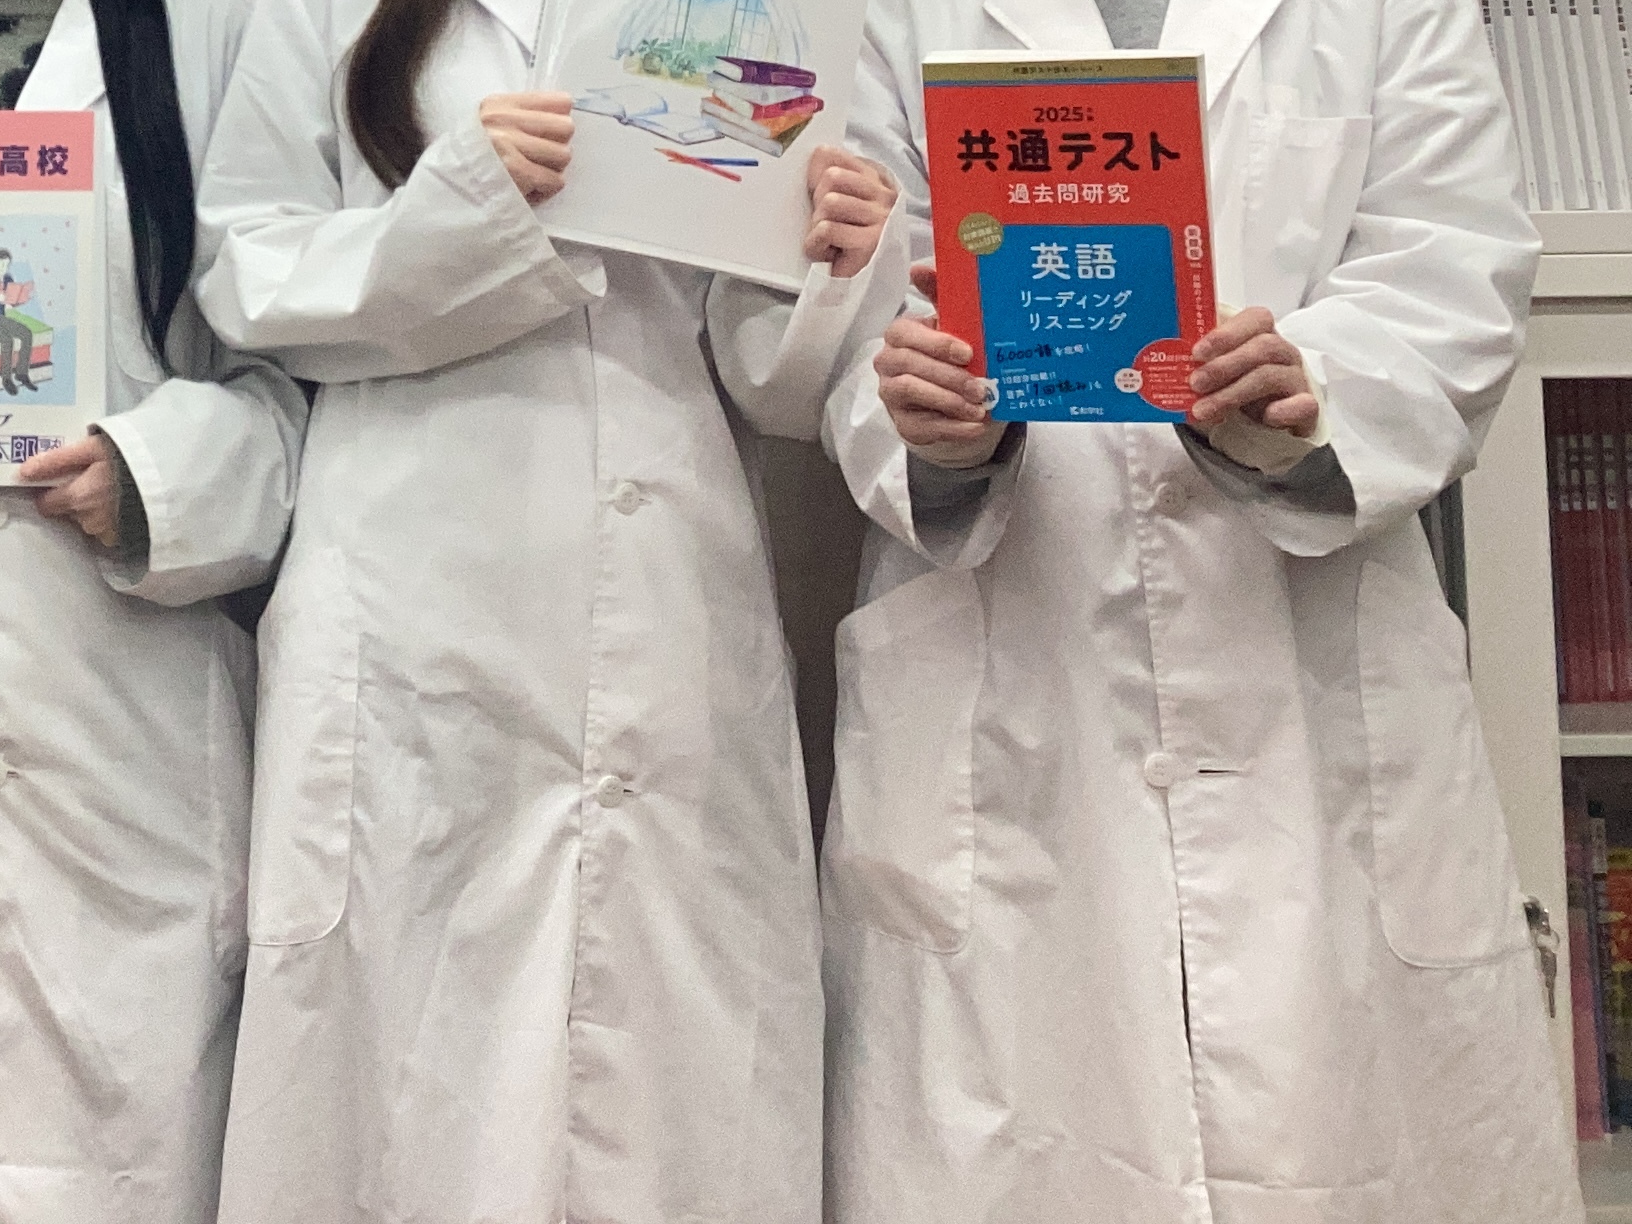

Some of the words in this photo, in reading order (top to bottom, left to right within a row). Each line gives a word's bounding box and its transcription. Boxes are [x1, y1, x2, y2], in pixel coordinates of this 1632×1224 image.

[957, 128, 1180, 172] 共通テスト
[1008, 183, 1130, 204] 過去問研究
[1030, 242, 1117, 280] 英語
[1021, 290, 1132, 309] リーディング
[1029, 312, 1127, 331] リスニング
